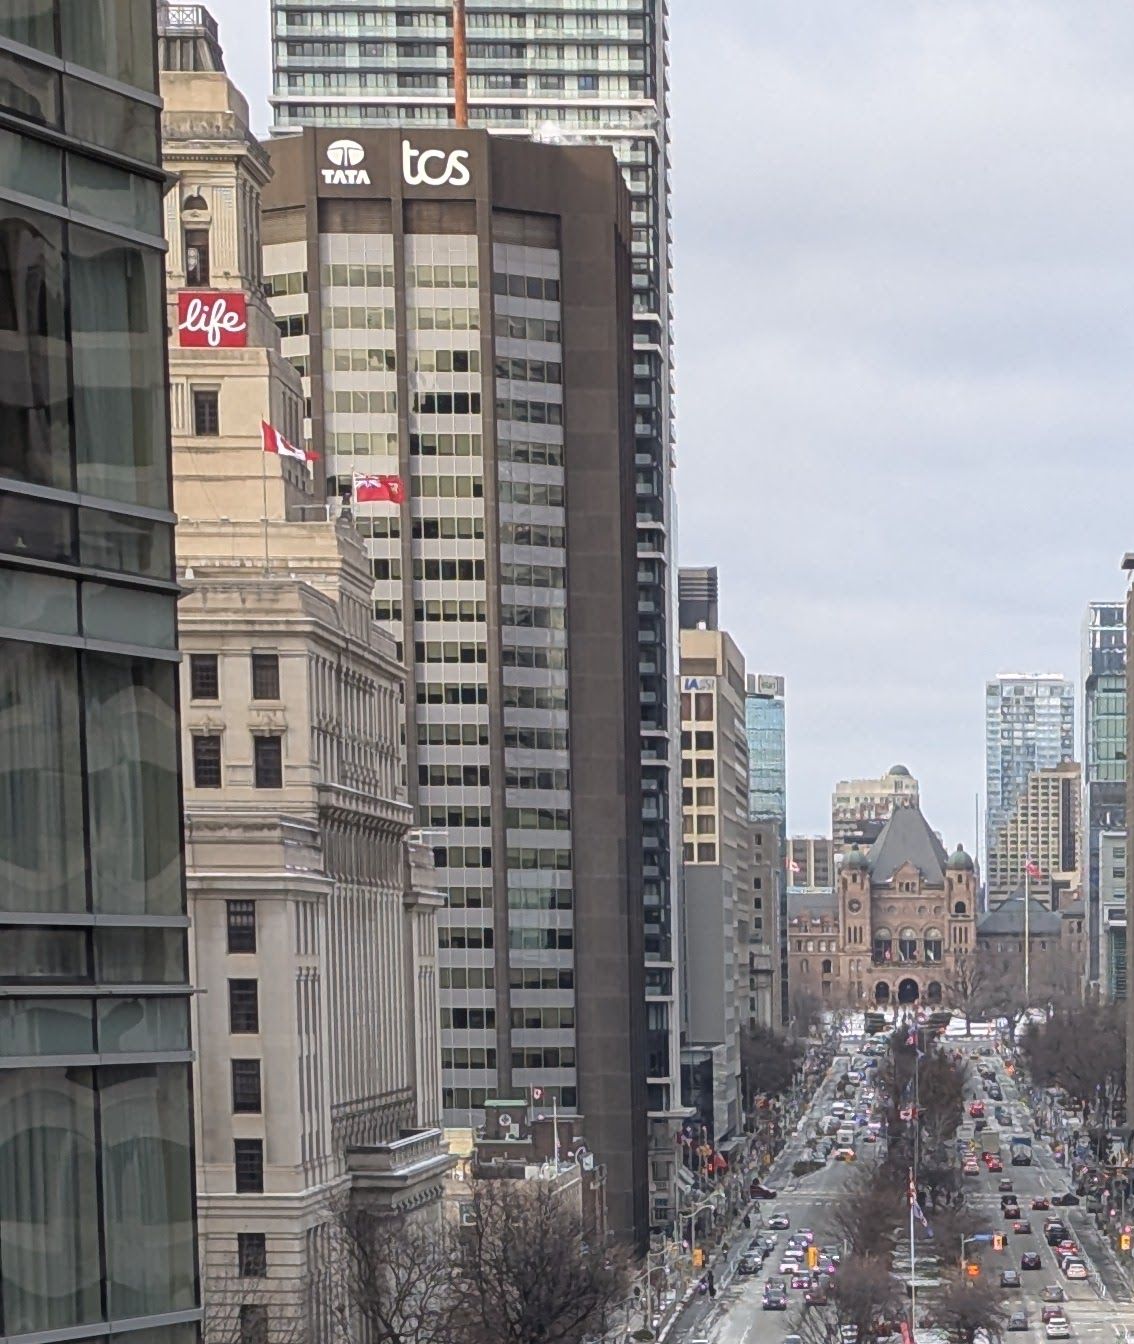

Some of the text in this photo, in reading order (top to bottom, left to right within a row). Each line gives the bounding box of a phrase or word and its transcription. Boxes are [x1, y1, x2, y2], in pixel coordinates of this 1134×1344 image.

[321, 169, 371, 185] TATA
[402, 139, 470, 186] tcs
[178, 298, 247, 346] life
